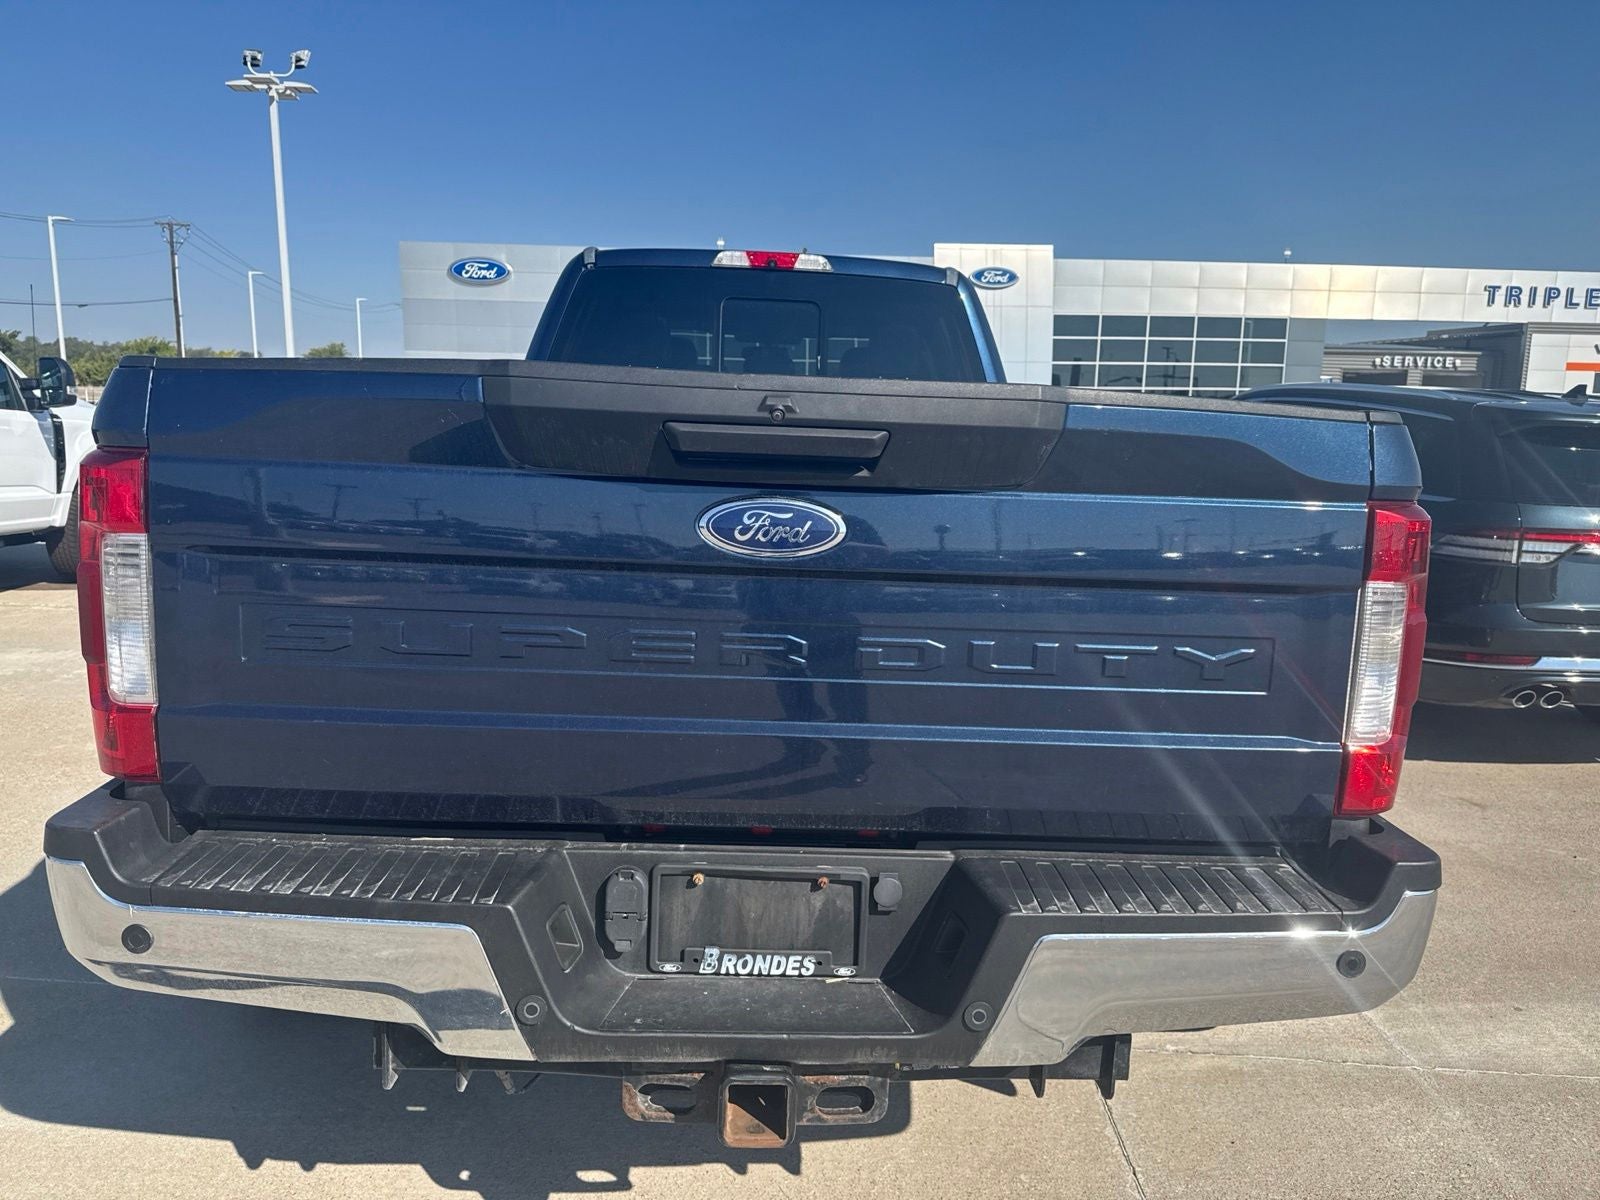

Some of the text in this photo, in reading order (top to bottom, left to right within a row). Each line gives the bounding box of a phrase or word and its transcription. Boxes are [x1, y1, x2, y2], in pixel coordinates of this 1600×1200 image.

[462, 262, 498, 278] Ford
[981, 270, 1009, 283] Ford
[1484, 284, 1600, 309] TRIPLE
[1382, 355, 1455, 368] SERVICE
[734, 510, 813, 543] Ford
[264, 615, 1256, 680] SUPER DUTY
[700, 946, 816, 976] BRONDES
